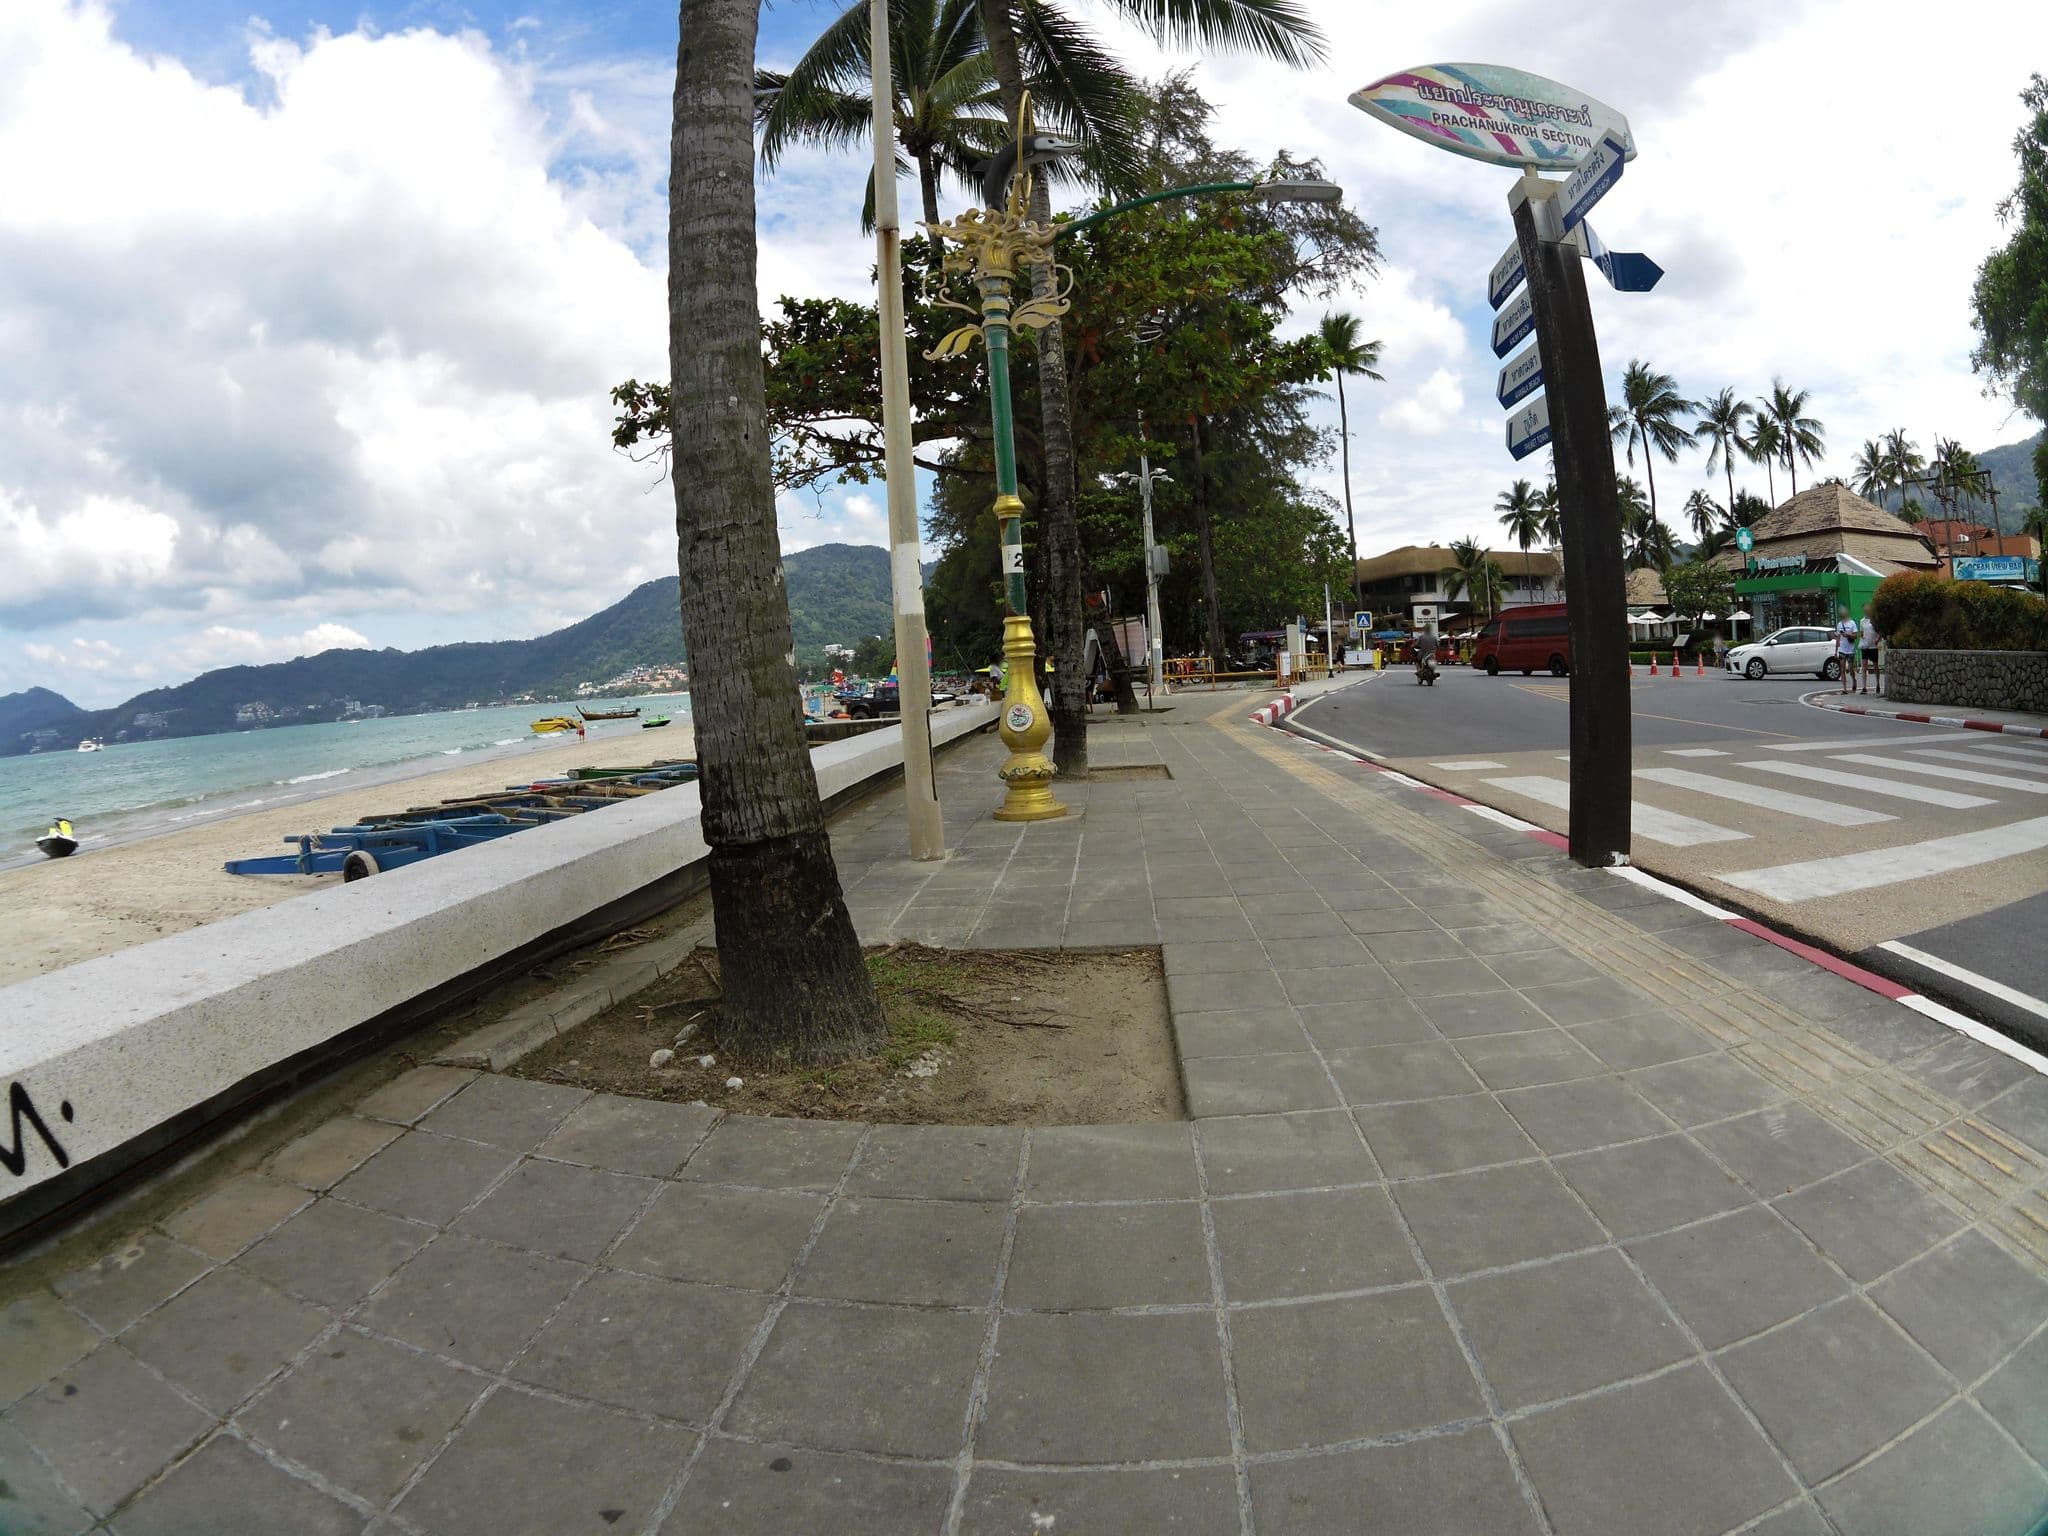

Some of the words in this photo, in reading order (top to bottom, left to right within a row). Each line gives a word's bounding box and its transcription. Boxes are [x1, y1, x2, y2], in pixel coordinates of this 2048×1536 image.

[1418, 84, 1592, 127] แยกประชานุเคราะห์
[1432, 112, 1538, 138] PRACHANUKROH
[1541, 128, 1592, 148] SECTION
[1967, 562, 1990, 571] OCEAN
